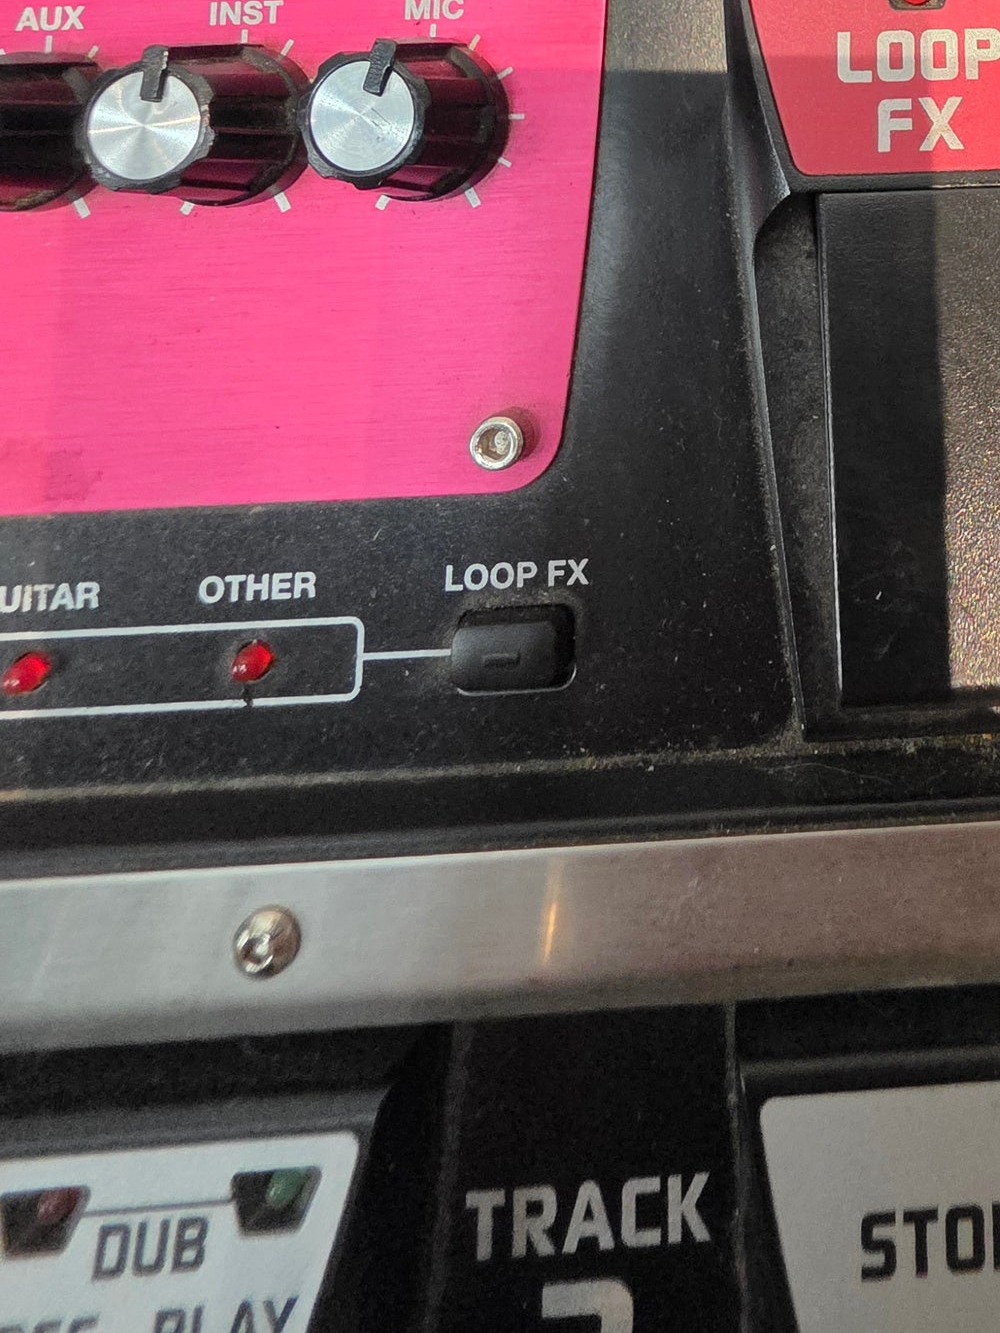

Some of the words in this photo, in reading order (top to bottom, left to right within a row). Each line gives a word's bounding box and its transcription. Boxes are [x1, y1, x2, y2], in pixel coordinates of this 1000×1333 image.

[15, 5, 86, 31] AUX
[209, 0, 284, 25] INST
[876, 96, 964, 153] FX
[198, 571, 317, 604] OTHER
[444, 562, 538, 592] LOOP
[547, 558, 590, 585] FX
[465, 1172, 711, 1261] TRACK
[91, 1217, 209, 1282] DUB
